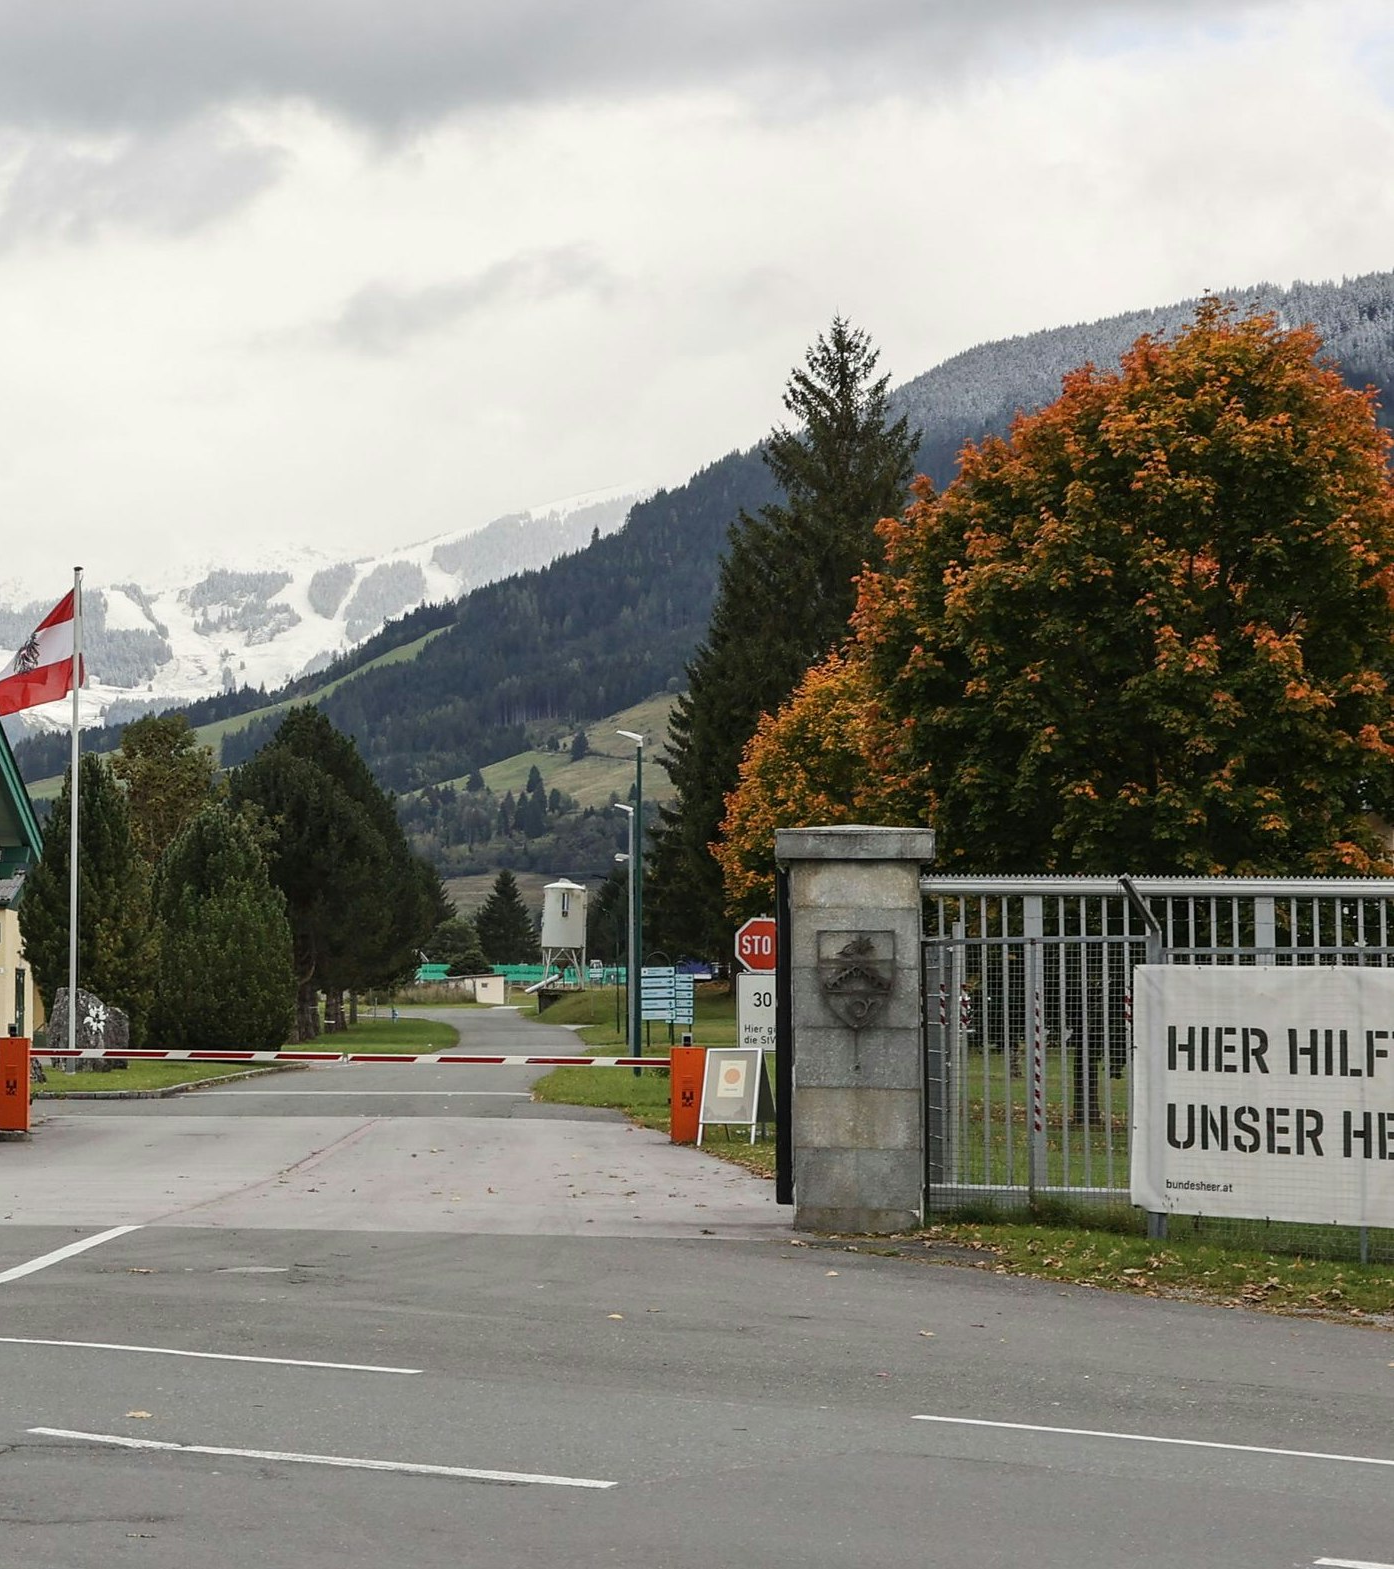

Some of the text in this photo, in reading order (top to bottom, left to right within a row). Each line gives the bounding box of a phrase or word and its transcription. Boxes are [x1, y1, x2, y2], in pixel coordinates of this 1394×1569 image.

[742, 935, 771, 955] STO
[753, 992, 772, 1007] 30
[744, 1024, 763, 1034] Hier
[744, 1036, 757, 1044] die
[1167, 1025, 1394, 1078] HIER HILF
[1167, 1103, 1394, 1160] UNSER HE
[1165, 1178, 1234, 1193] bundesheer.at
